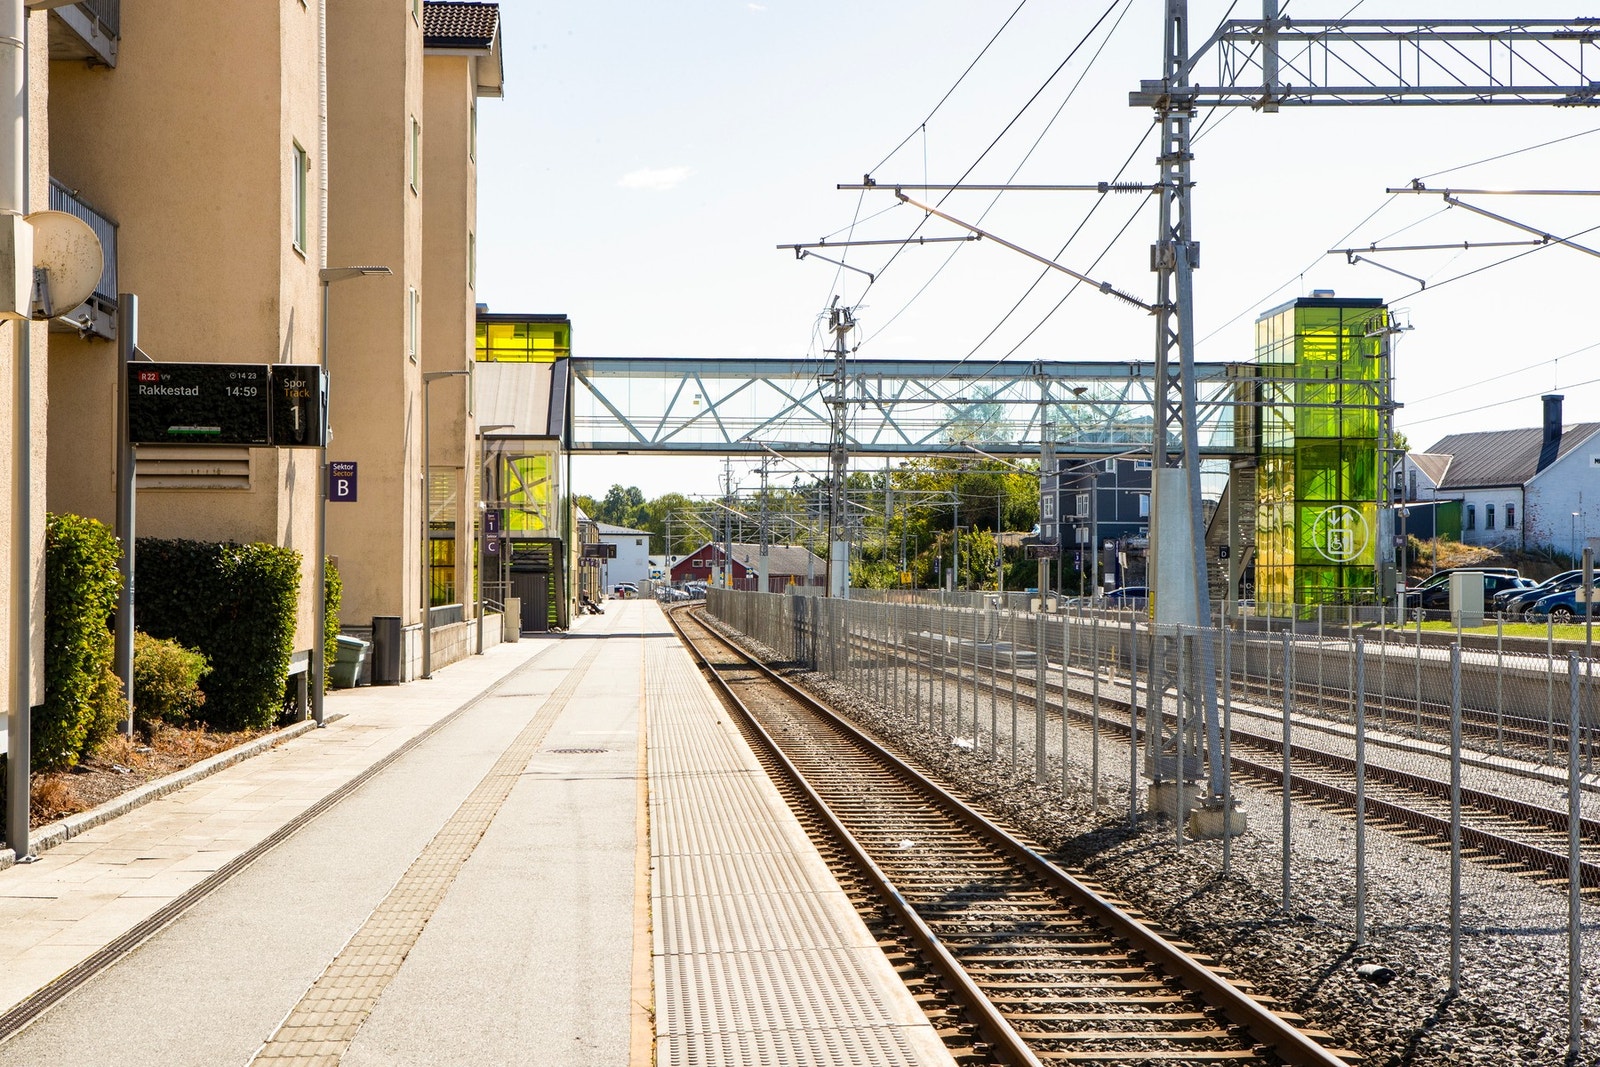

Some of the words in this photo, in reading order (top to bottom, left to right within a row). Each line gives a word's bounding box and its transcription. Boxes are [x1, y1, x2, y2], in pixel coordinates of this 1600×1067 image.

[283, 378, 306, 389] Spor
[138, 385, 199, 396] Rakkestad
[226, 386, 257, 397] 14:59
[284, 388, 310, 398] Track
[290, 405, 300, 430] 1
[338, 479, 349, 496] B
[489, 522, 493, 531] 1
[488, 542, 496, 552] C
